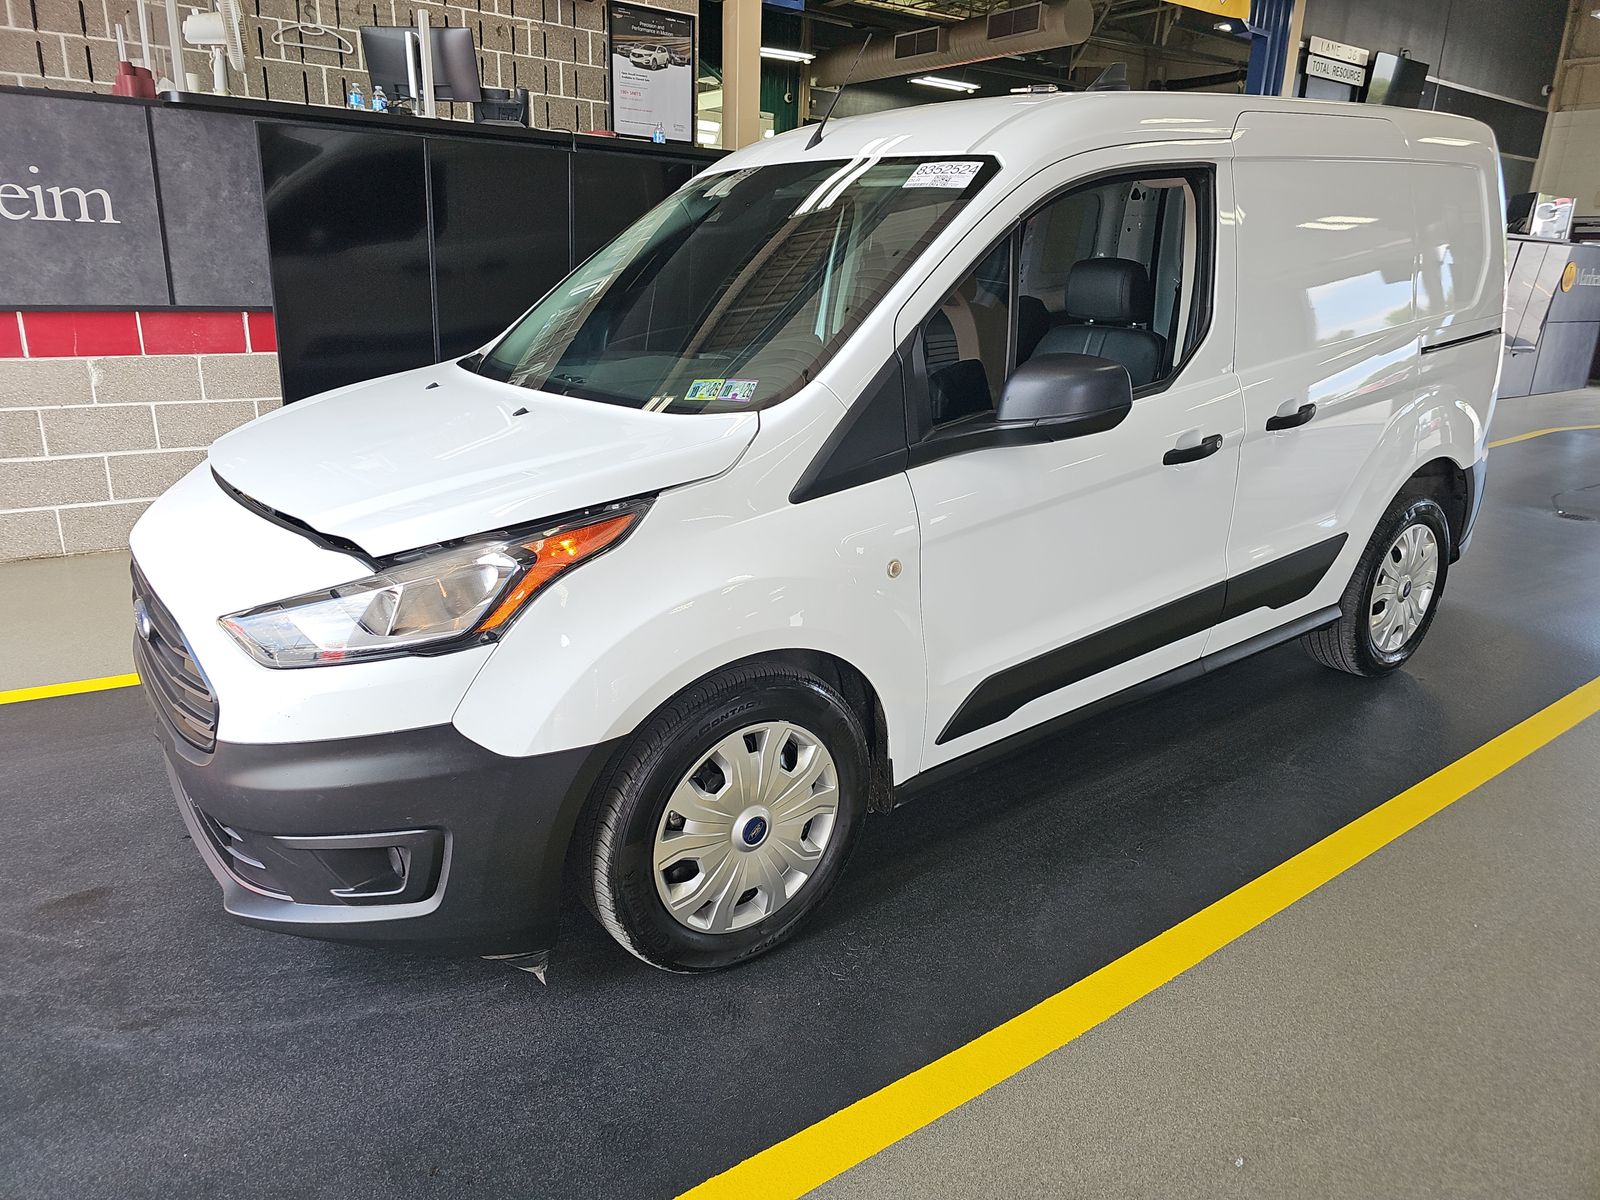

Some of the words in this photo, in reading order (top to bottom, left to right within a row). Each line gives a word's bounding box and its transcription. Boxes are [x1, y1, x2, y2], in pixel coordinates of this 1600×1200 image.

[1320, 41, 1341, 57] LANE
[1312, 60, 1330, 75] TOTAL
[1331, 65, 1361, 82] RESOURCE
[916, 164, 979, 175] 8352524
[0, 165, 121, 224] eim
